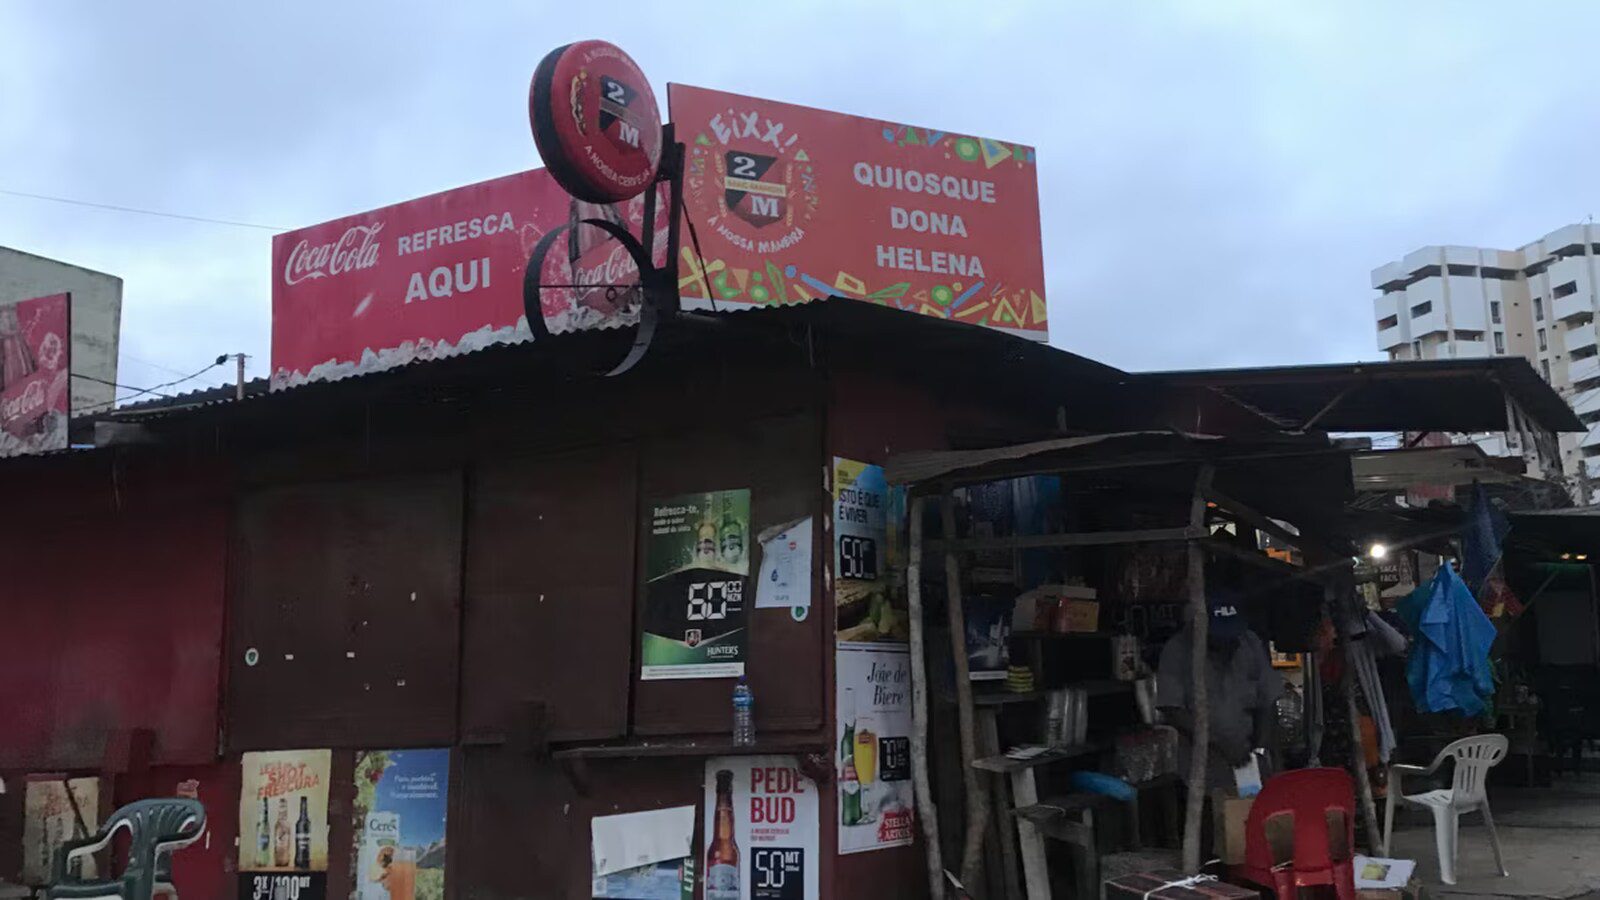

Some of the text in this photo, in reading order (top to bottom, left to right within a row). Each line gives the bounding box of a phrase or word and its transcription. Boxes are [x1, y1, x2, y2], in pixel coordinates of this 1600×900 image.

[607, 81, 625, 105] 2
[618, 120, 640, 149] M
[589, 152, 617, 182] NOSSA
[733, 156, 756, 177] 2
[853, 161, 996, 203] QUIOSQUE
[751, 195, 779, 217] M
[398, 211, 515, 256] REFRESCA
[707, 215, 719, 226] A
[716, 225, 754, 252] NOSSA
[890, 206, 968, 238] DONA
[876, 245, 985, 279] HELENA
[405, 256, 490, 304] AQUI
[841, 537, 863, 578] 50
[687, 581, 727, 620] 60
[867, 662, 907, 683] Joie de
[750, 767, 805, 794] PEDE
[750, 797, 796, 824] BUD
[884, 816, 911, 829] STELLA
[756, 851, 785, 888] 50
[785, 852, 800, 864] MT
[682, 857, 695, 893] LITE
